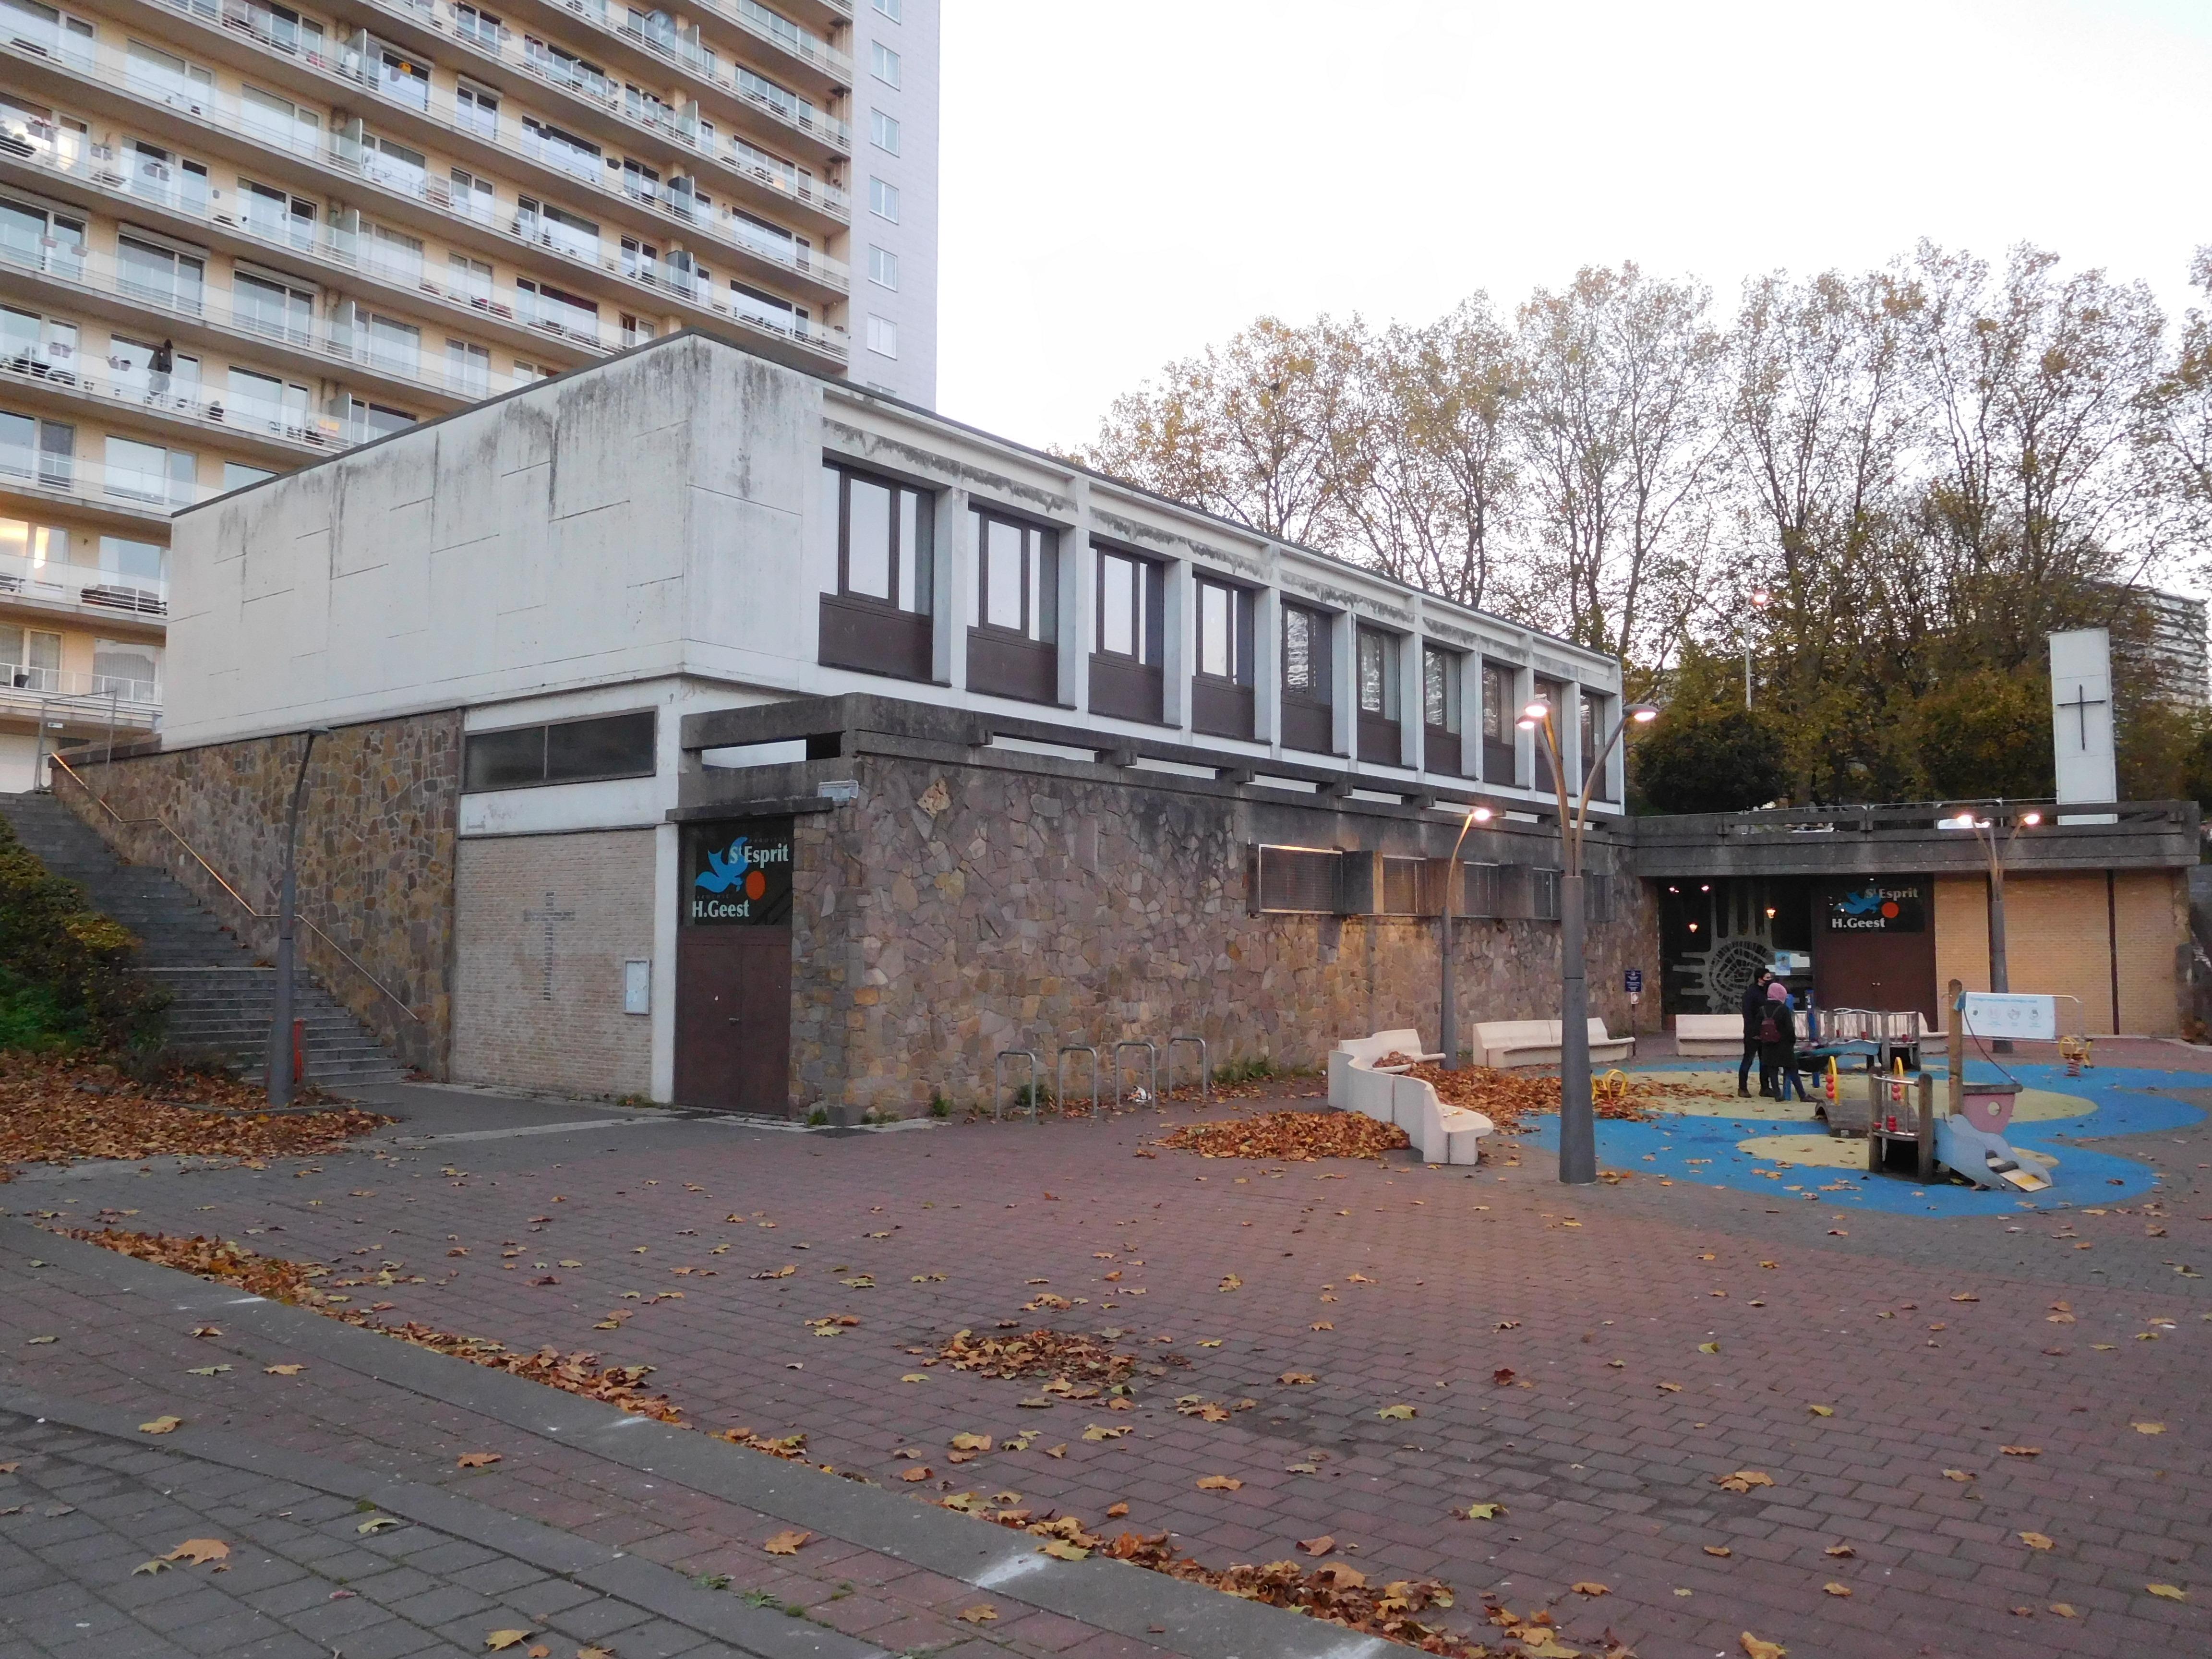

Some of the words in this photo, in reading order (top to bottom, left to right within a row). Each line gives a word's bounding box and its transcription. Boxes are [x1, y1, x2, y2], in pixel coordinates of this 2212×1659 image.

[744, 843, 789, 868] Esprit
[1879, 888, 1918, 901] Esprit
[692, 899, 749, 917] H.Geest
[1832, 917, 1886, 928] H.Geest
